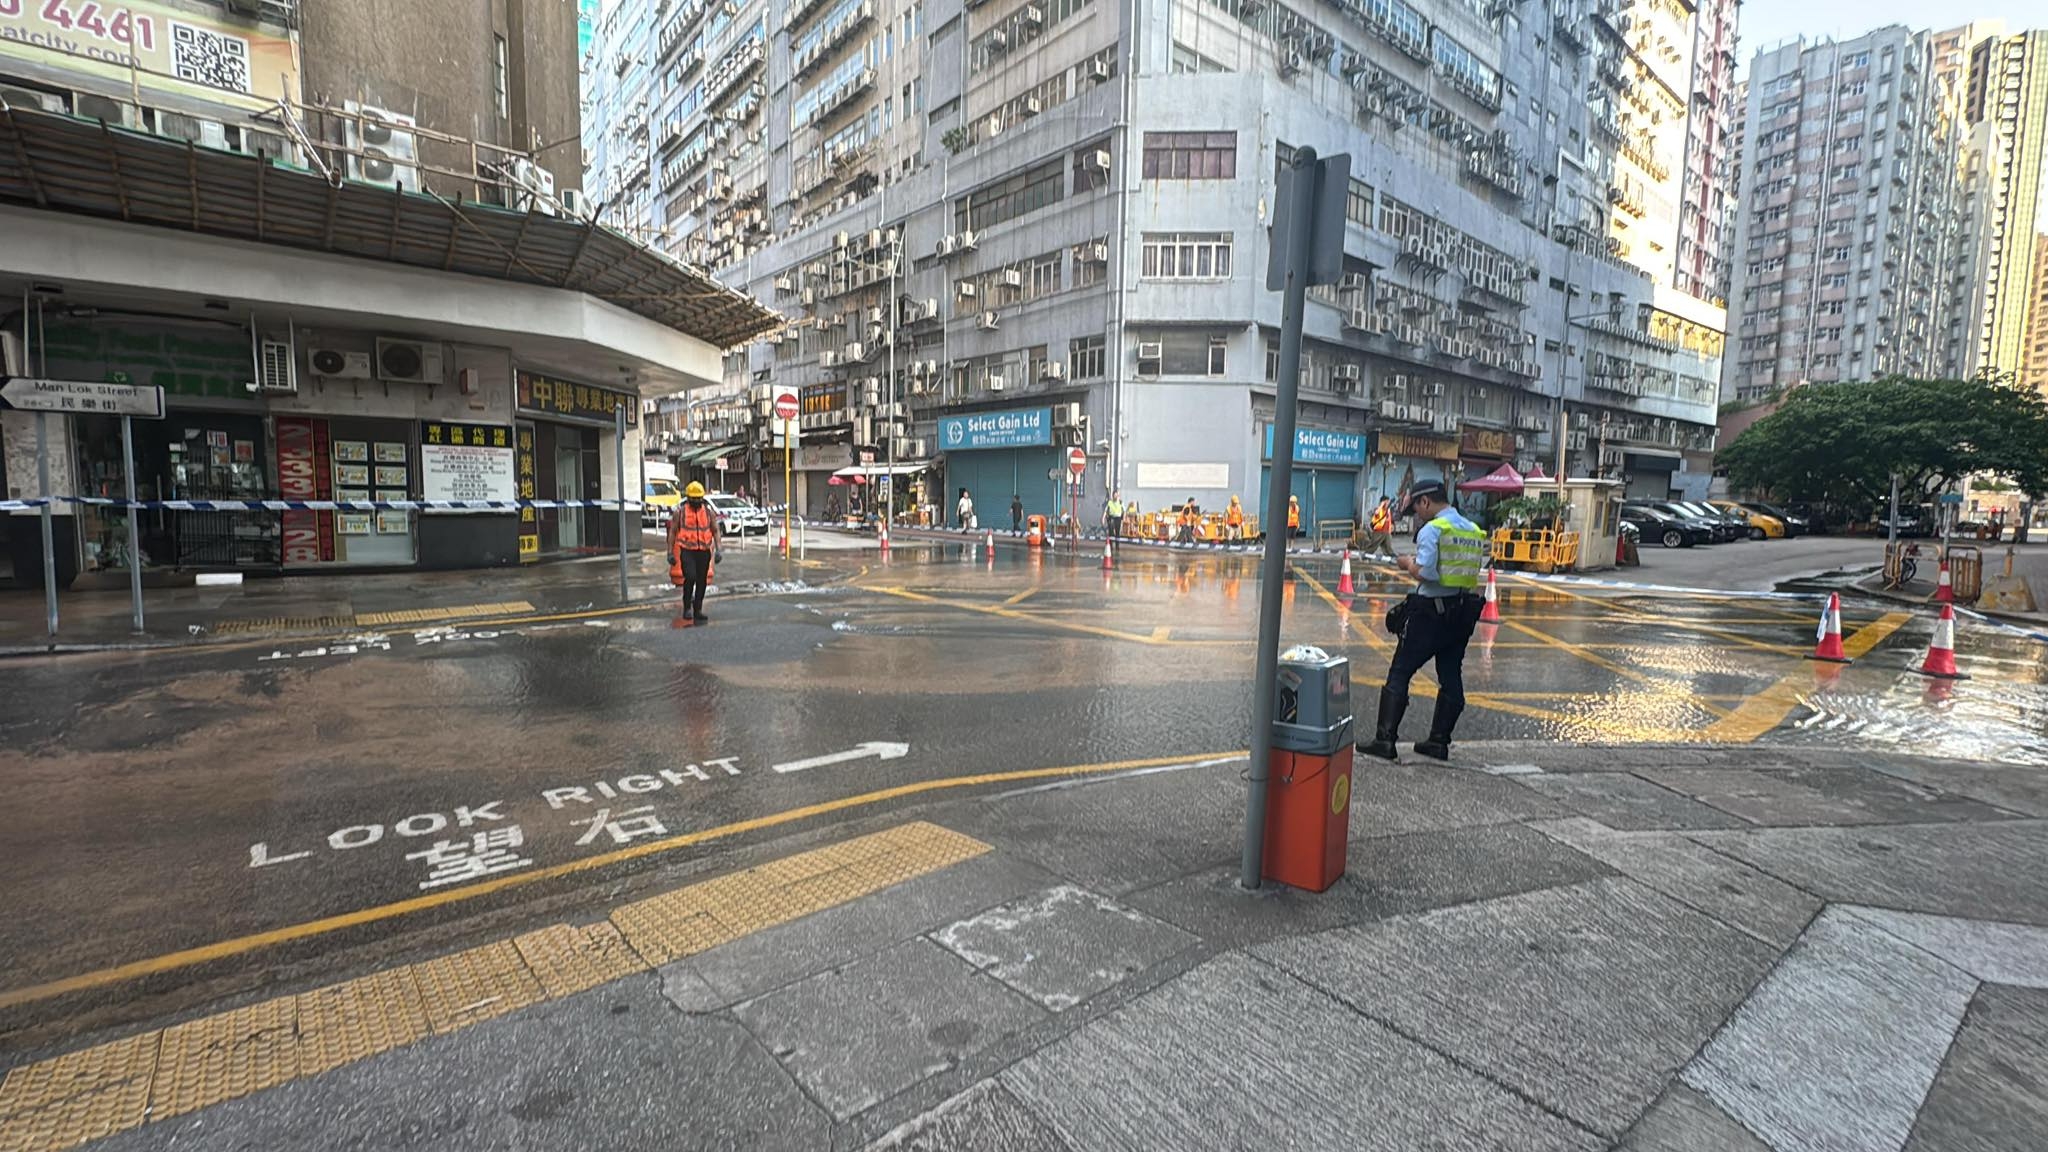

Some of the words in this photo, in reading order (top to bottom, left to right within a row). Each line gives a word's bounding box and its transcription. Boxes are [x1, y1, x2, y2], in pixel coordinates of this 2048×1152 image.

[35, 381, 63, 393] Man
[68, 384, 92, 394] Lok
[98, 386, 138, 397] Street
[968, 416, 996, 432] Select
[998, 414, 1020, 429] Gain
[1023, 412, 1040, 428] Ltd
[1298, 430, 1324, 446] Select
[1326, 434, 1344, 449] Gain
[1346, 436, 1359, 450] Ltd
[1459, 537, 1476, 547] POLICE
[247, 799, 507, 870] LOOK
[541, 755, 745, 812] RIGHT
